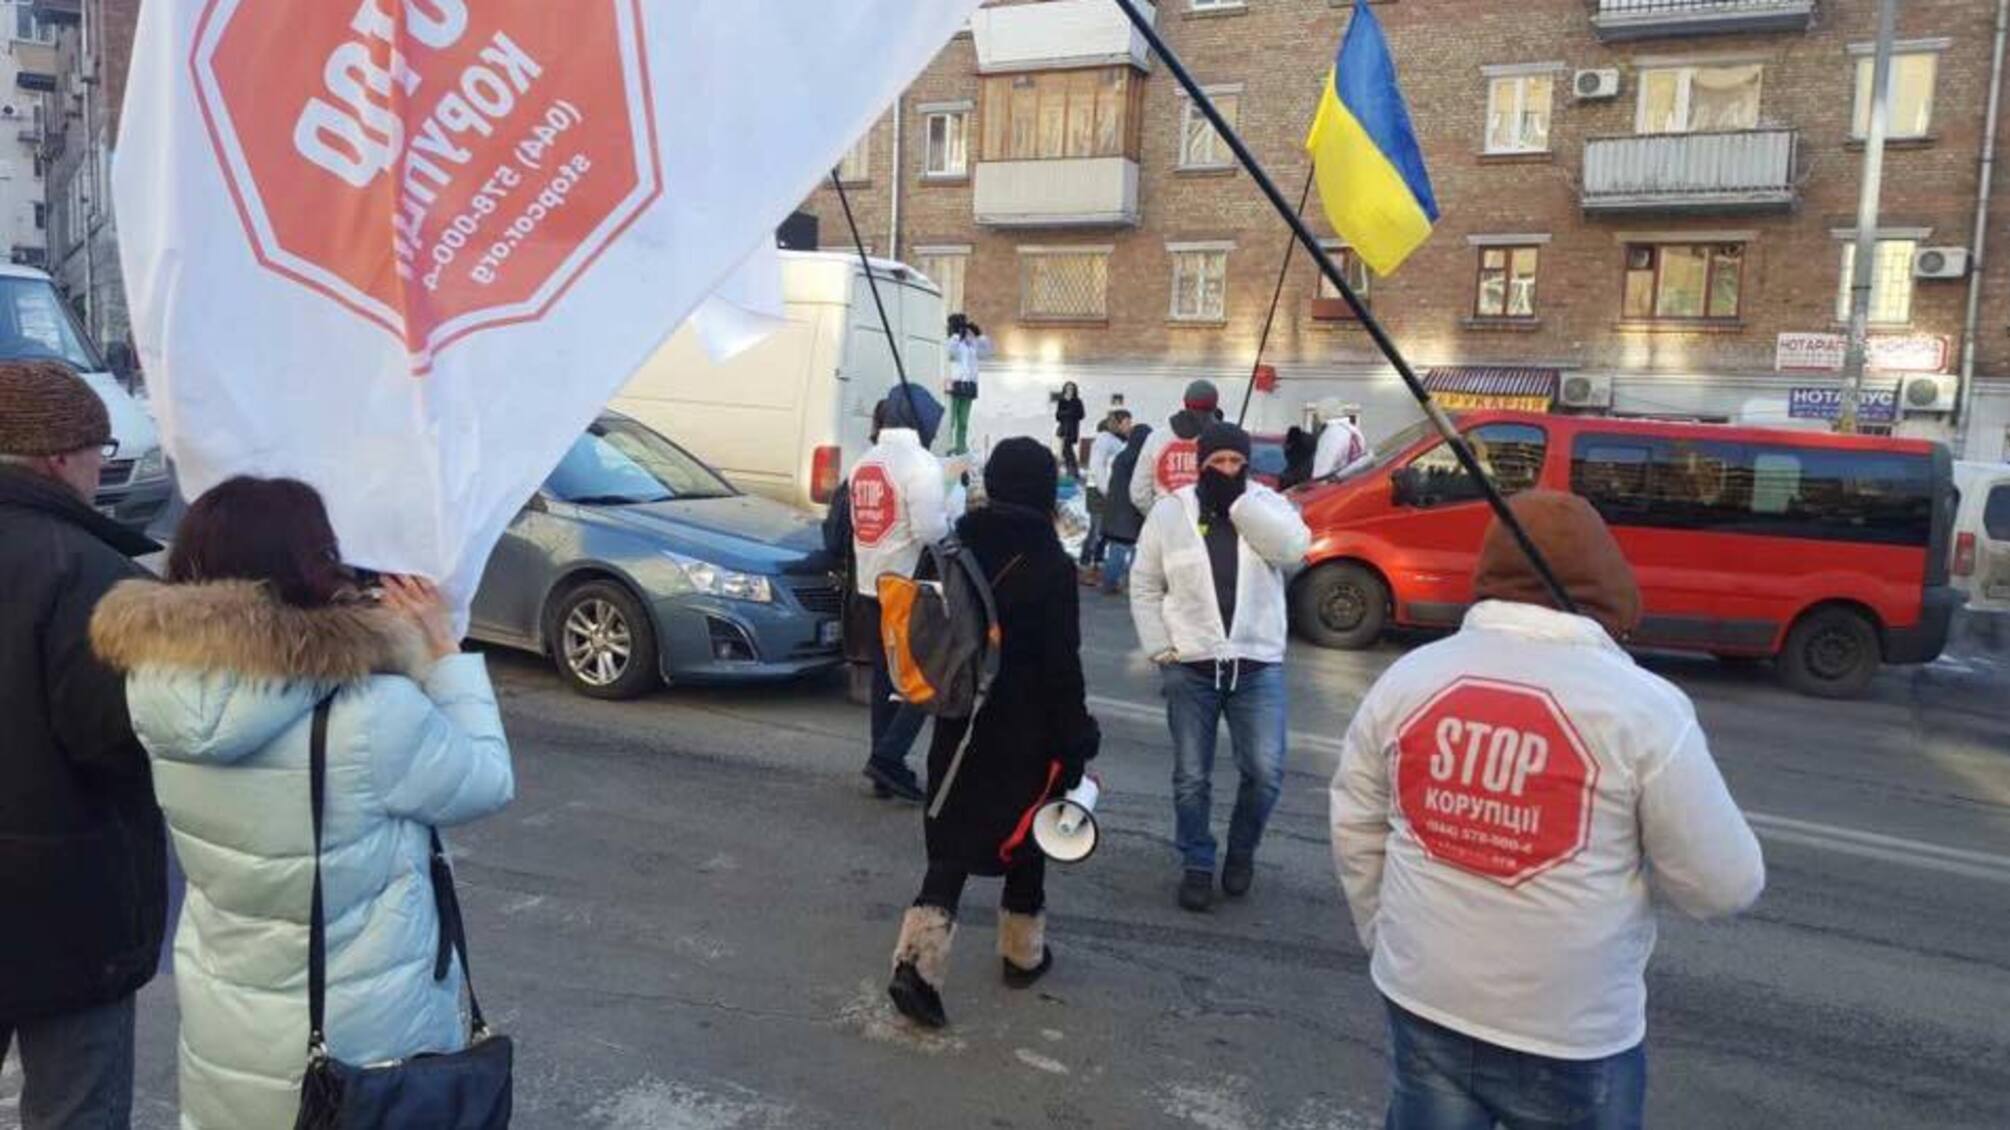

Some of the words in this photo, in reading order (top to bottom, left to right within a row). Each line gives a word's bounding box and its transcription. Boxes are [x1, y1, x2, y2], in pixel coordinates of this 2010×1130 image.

[1793, 390, 1894, 404] НОТАІУС
[854, 480, 884, 506] STOP
[1429, 717, 1550, 796] STOP
[1424, 788, 1541, 833] КОРУПЦІЇ
